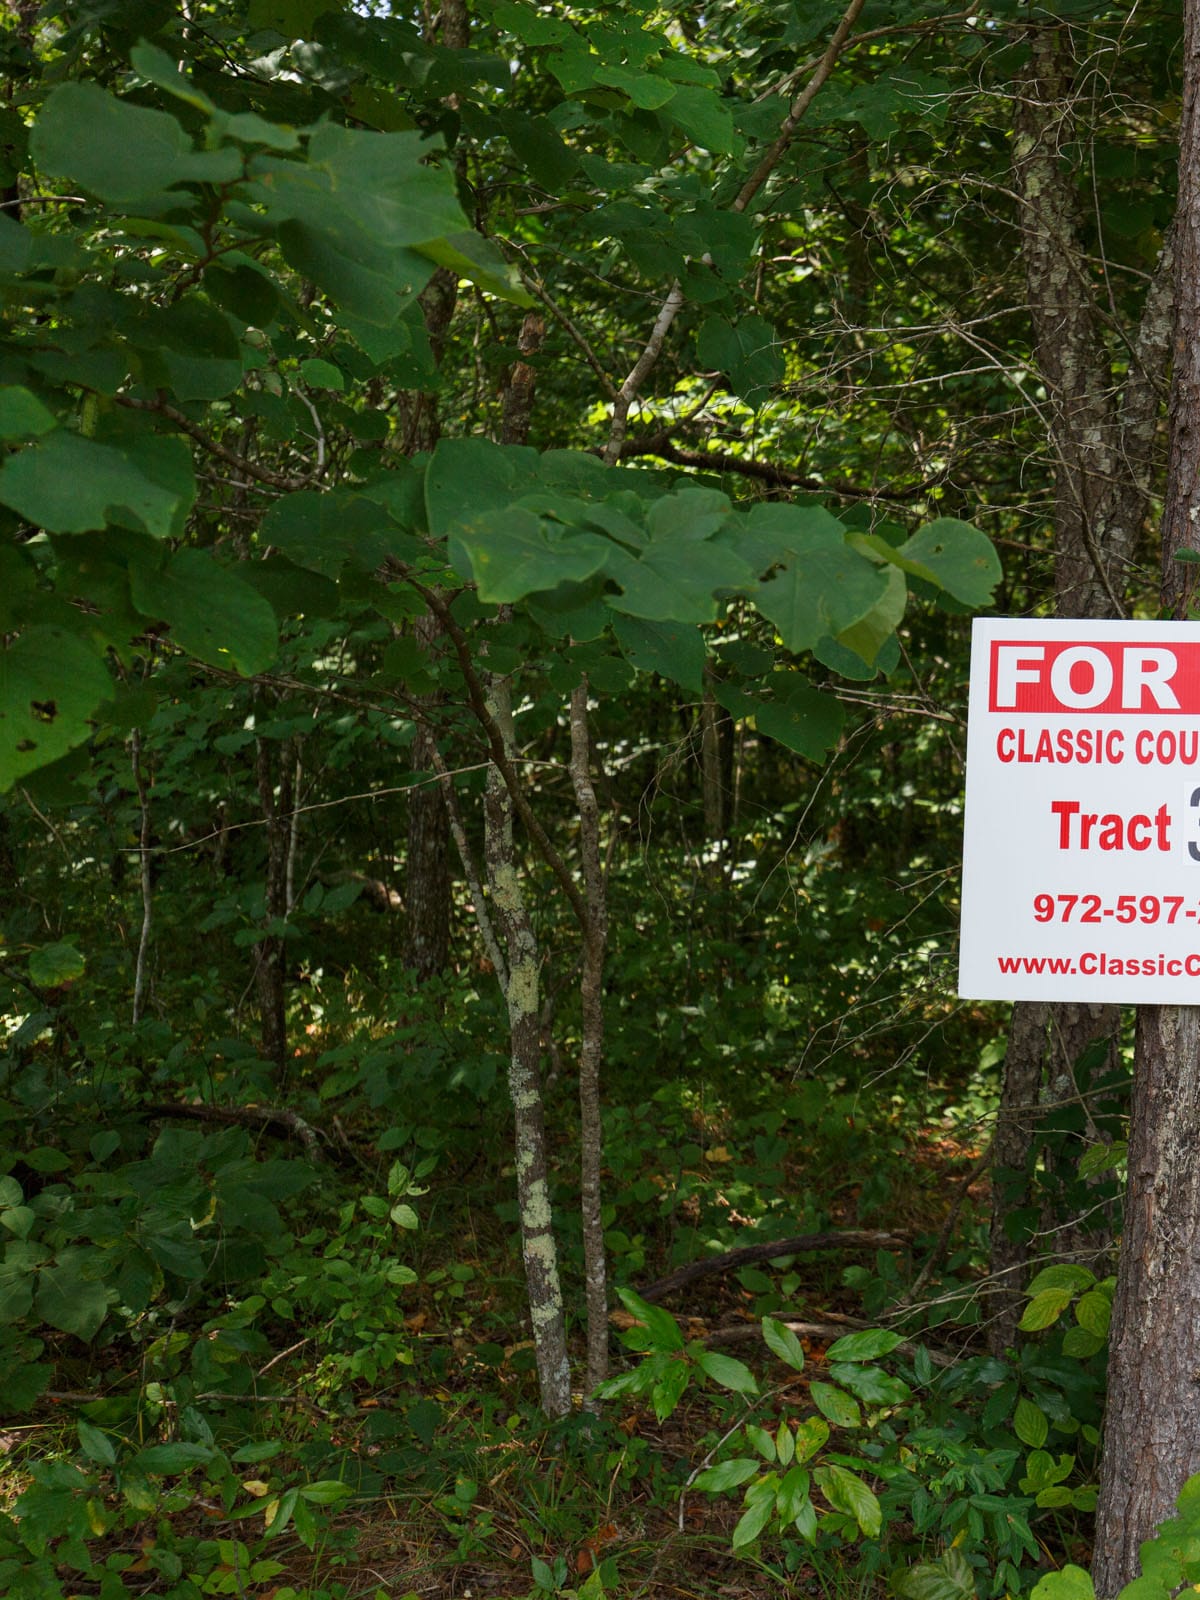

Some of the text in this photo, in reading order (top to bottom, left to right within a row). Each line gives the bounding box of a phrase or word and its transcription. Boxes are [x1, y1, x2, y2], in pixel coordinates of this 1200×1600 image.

[996, 646, 1181, 709] FOR
[997, 728, 1124, 764] CLASSIC
[1051, 801, 1171, 851] Tract
